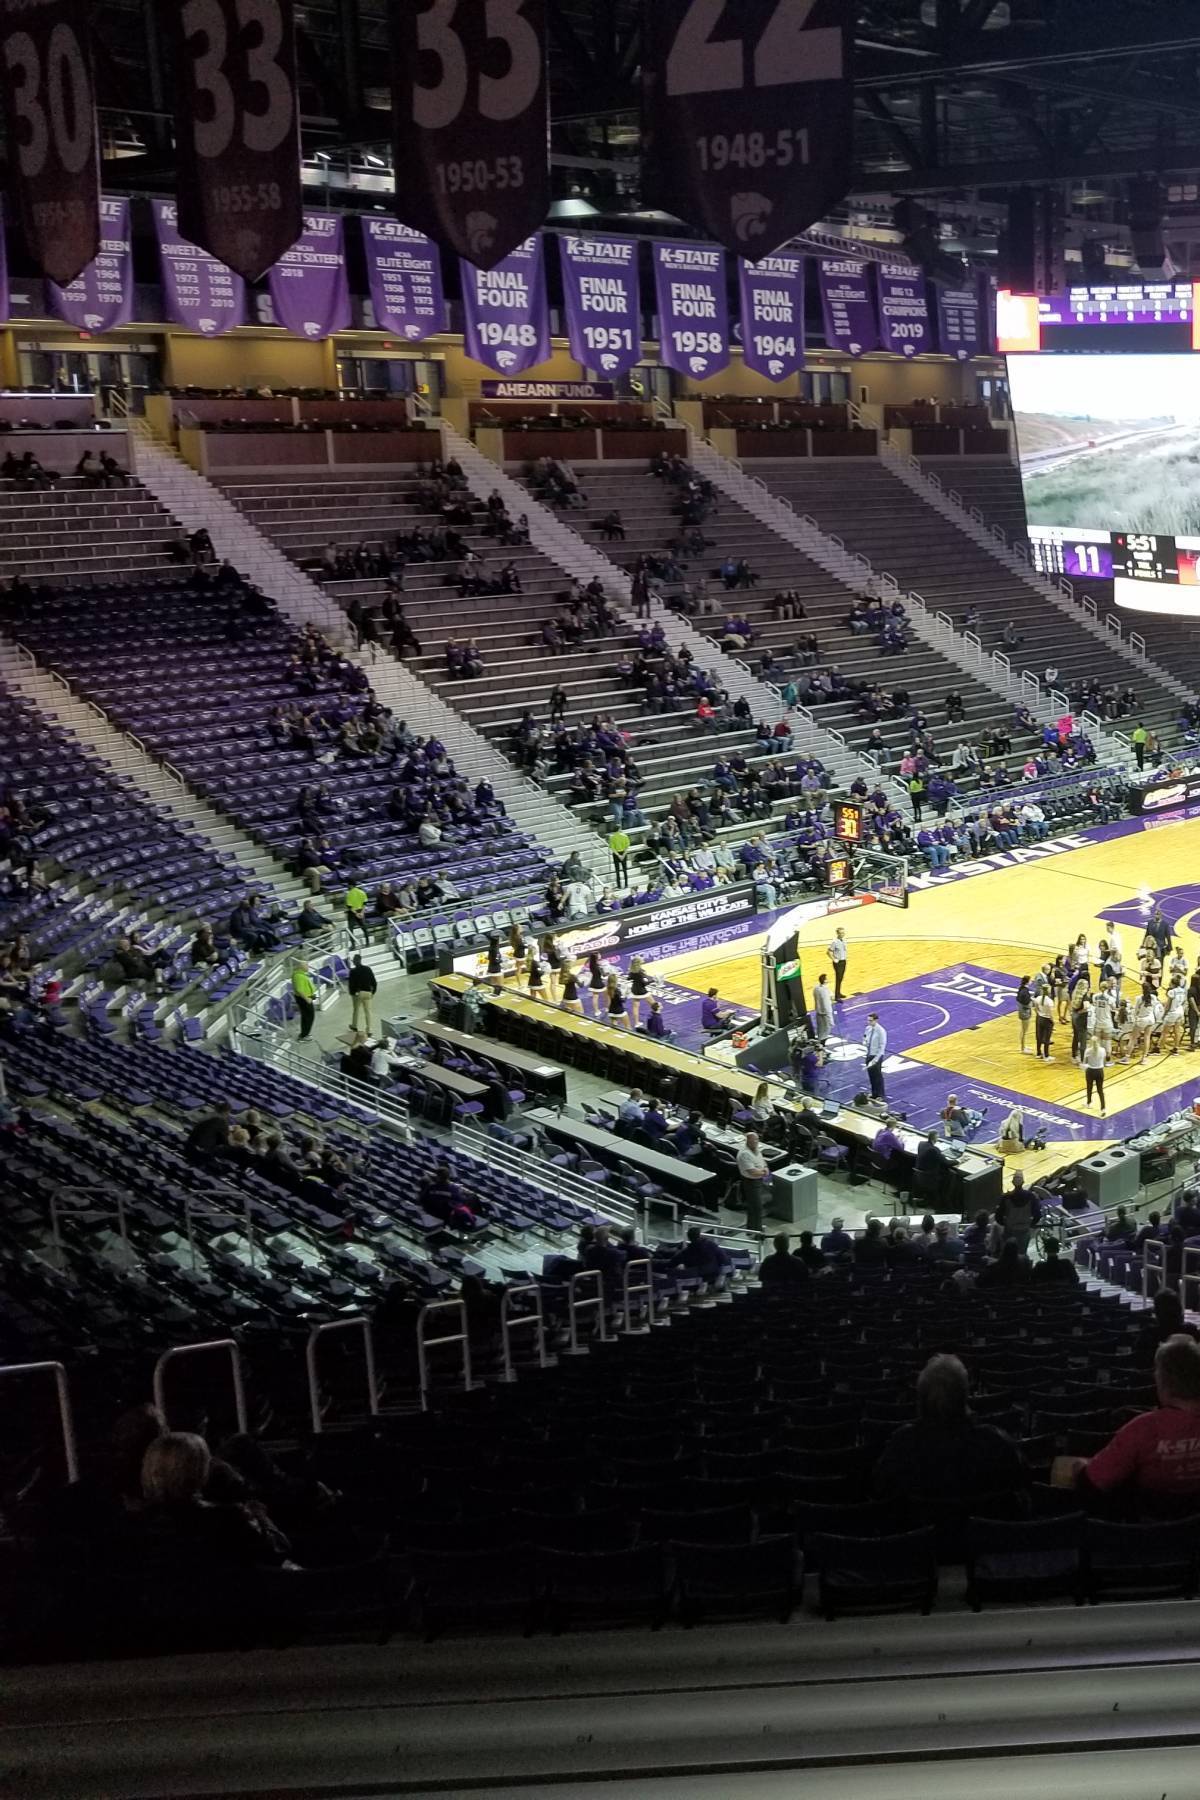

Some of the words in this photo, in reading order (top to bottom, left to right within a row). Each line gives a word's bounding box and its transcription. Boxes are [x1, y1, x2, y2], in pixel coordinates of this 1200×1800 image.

[182, 0, 293, 157] 33
[5, 23, 91, 177] 30
[697, 129, 810, 171] 1948-51
[435, 156, 525, 195] 1950-53
[211, 182, 282, 213] 1955-58
[99, 240, 130, 252] TEEN
[566, 240, 632, 258] K-STATE
[173, 262, 198, 272] 1972
[303, 253, 344, 265] SIXTEEN
[376, 257, 402, 268] ELITE
[403, 259, 432, 270] EIGHT
[659, 248, 720, 266] K-STATE
[476, 270, 528, 290] FINAL
[579, 276, 627, 296] FINAL
[477, 289, 528, 308] FOUR
[671, 283, 716, 302] FINAL
[753, 289, 793, 307] FINAL
[581, 295, 628, 313] FOUR
[672, 300, 716, 318] FOUR
[753, 305, 793, 323] FOUR
[476, 322, 537, 346] 1948
[583, 327, 633, 350] 1951
[891, 323, 923, 337] 2019
[672, 331, 723, 353] 1958
[753, 335, 796, 357] 1964
[1126, 534, 1157, 551] 5:51
[1075, 545, 1100, 573] 11
[837, 818, 858, 839] 30
[906, 834, 1099, 888] K-STATE
[628, 922, 660, 937] HOME
[660, 918, 677, 930] OF
[677, 913, 699, 927] THE
[699, 899, 749, 921] WILDCATS
[650, 903, 695, 921] KANSAS
[696, 897, 728, 911] CITY'S
